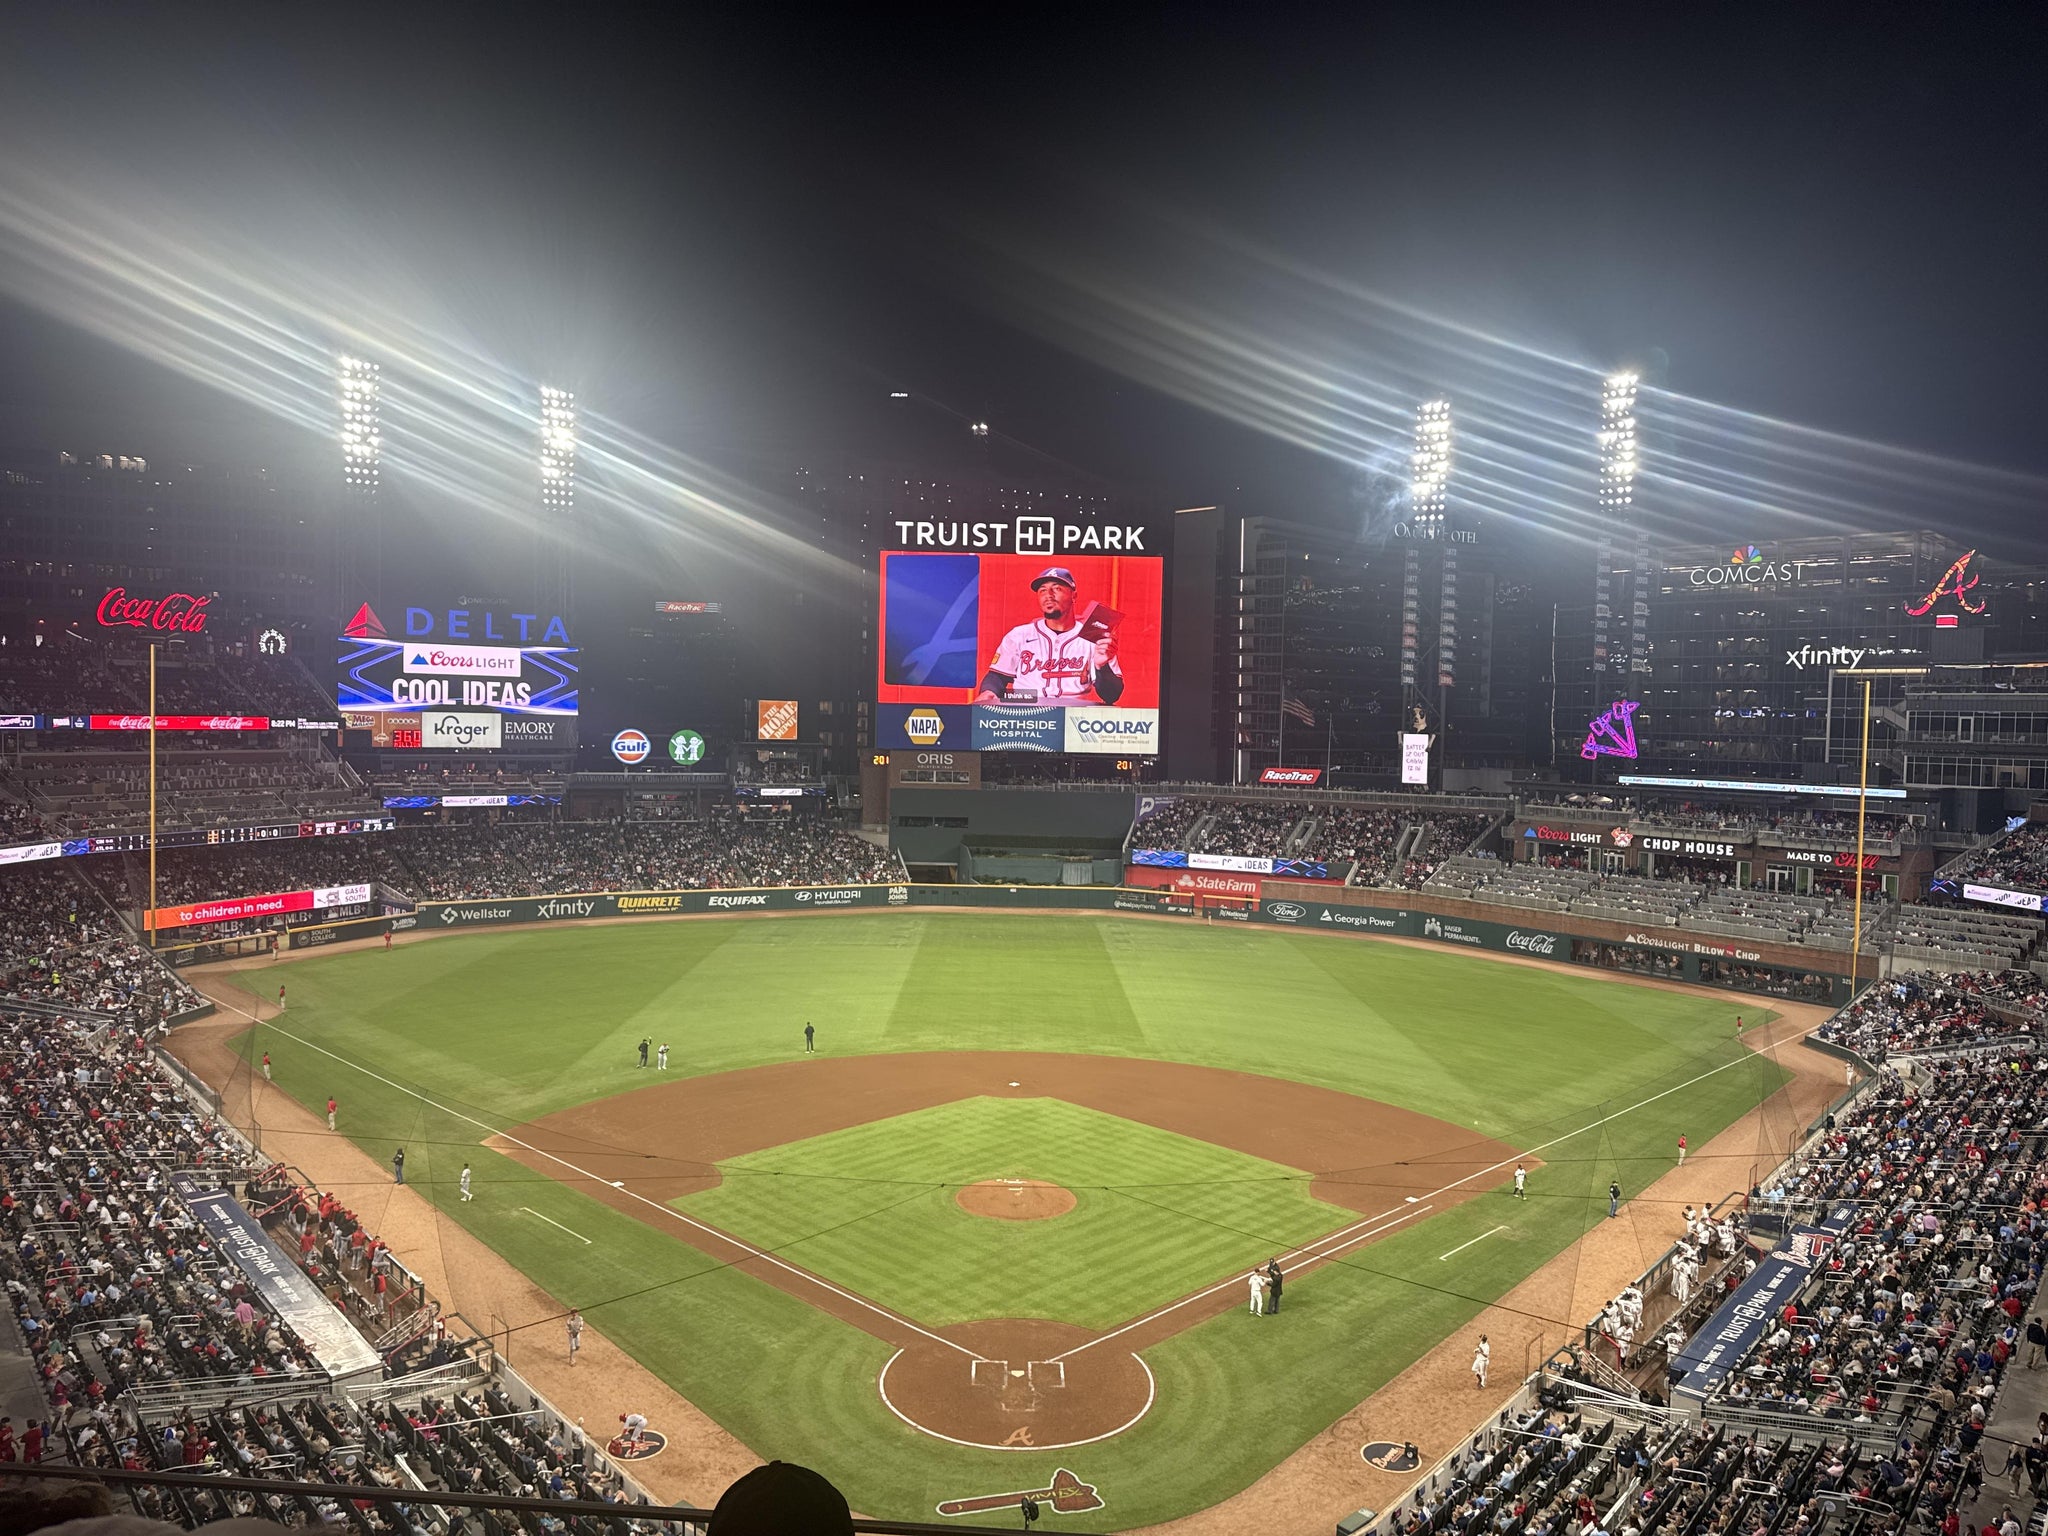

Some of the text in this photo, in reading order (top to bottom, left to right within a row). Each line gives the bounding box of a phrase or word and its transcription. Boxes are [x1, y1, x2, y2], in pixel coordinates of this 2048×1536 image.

[895, 521, 1145, 550] TRUIST PARK
[1690, 563, 1803, 585] COMCAST
[96, 587, 211, 632] Coca-Cola
[667, 603, 702, 612] RaceTrac
[406, 607, 569, 643] DELTA
[430, 651, 515, 669] Coors LIGHT
[1020, 650, 1084, 675] Braves
[1786, 645, 1864, 670] xfinity
[392, 678, 531, 706] COOL IDEAS
[763, 705, 779, 720] THE
[760, 701, 797, 739] HOME
[911, 719, 938, 734] NAPA
[979, 719, 1057, 730] NORTHSIDE
[1077, 720, 1154, 734] COOLRAY
[434, 716, 489, 744] Kroger
[505, 722, 555, 735] EMORY
[774, 716, 797, 739] DEPOT
[993, 730, 1042, 738] HOSPITAL
[394, 731, 421, 741] 360
[614, 740, 648, 753] Gulf
[917, 753, 954, 765] ORIS
[1264, 770, 1314, 783] RaceTrac
[1538, 826, 1602, 844] Coors LIGHT
[1643, 838, 1734, 857] CHOP HOUSE
[1787, 852, 1880, 869] MADE TO Chll
[815, 890, 861, 899] HYUNDAI
[889, 886, 908, 894] PAPA
[345, 893, 367, 902] SOUTH
[618, 896, 682, 908] QUIKRETE
[708, 895, 766, 908] EQUIFAX
[180, 899, 285, 921] to children in need.
[340, 904, 367, 917] MLB+
[461, 908, 511, 920] Wellstar
[538, 898, 594, 919] xfinity
[1273, 905, 1299, 917] Ford
[286, 911, 313, 924] MLB+
[1334, 913, 1396, 927] Georgia Power
[214, 921, 244, 933] MLB+
[311, 928, 331, 936] SOUTH
[311, 933, 336, 941] COLLEGE
[1444, 932, 1480, 943] PERMANENTE
[1506, 930, 1557, 954] Coca-Cola
[1637, 933, 1664, 947] Coors
[1664, 941, 1689, 951] LIGHT
[1694, 943, 1725, 956] BELOW
[1735, 949, 1760, 961] CHOP
[226, 1225, 257, 1248] TRUIST
[251, 1254, 280, 1275] PARK
[1717, 1313, 1752, 1342] TRUIST
[1748, 1288, 1775, 1310] PARK
[1771, 1232, 1812, 1268] Braves
